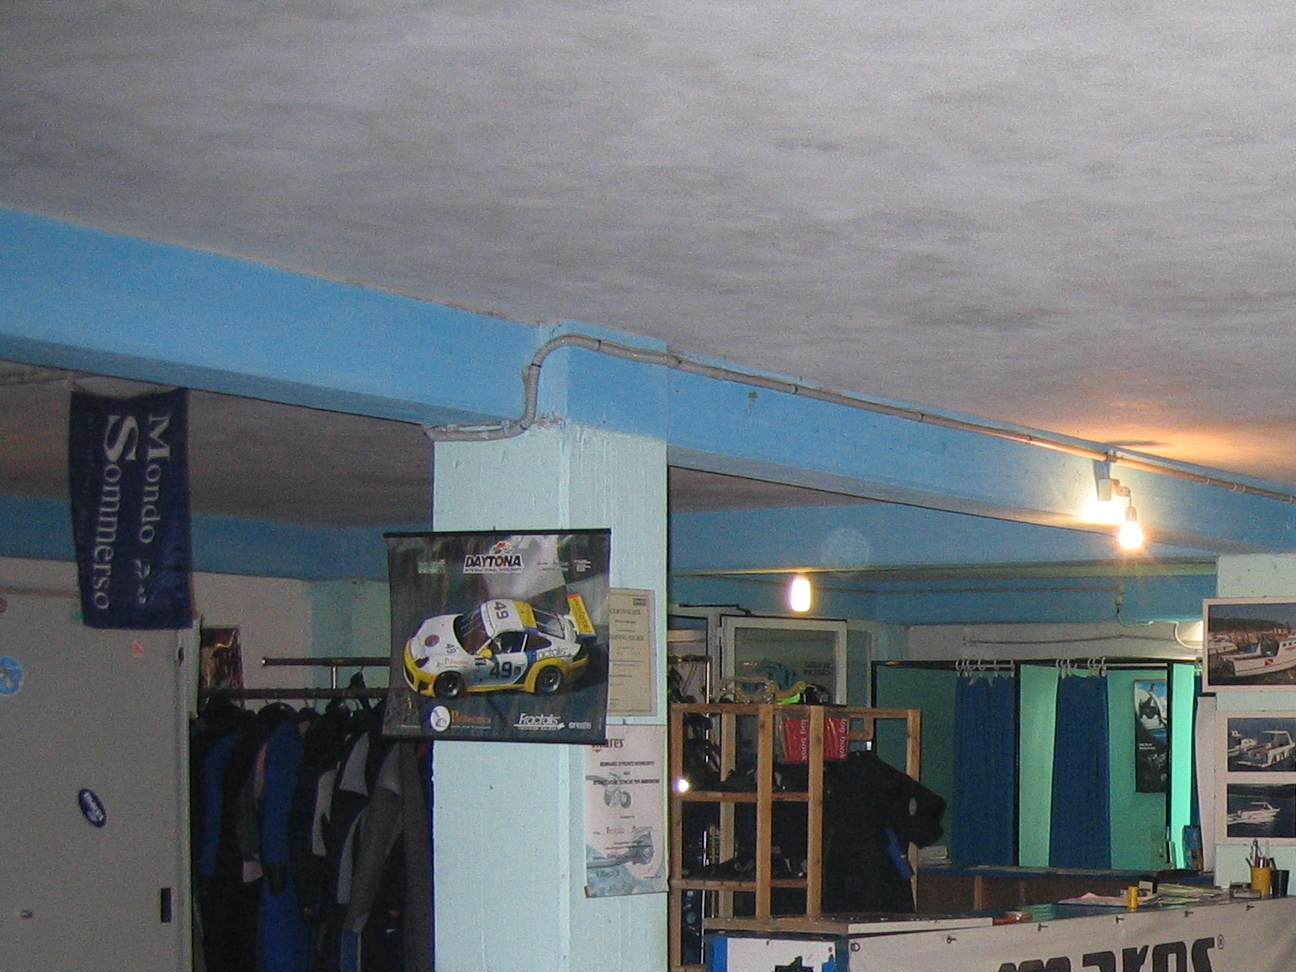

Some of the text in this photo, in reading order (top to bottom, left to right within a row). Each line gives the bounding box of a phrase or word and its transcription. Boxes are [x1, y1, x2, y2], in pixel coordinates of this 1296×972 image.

[139, 415, 171, 544] Mondo
[93, 415, 139, 610] Sommerso
[465, 556, 522, 567] DAYTONA
[494, 602, 510, 620] 49
[488, 661, 513, 678] 49
